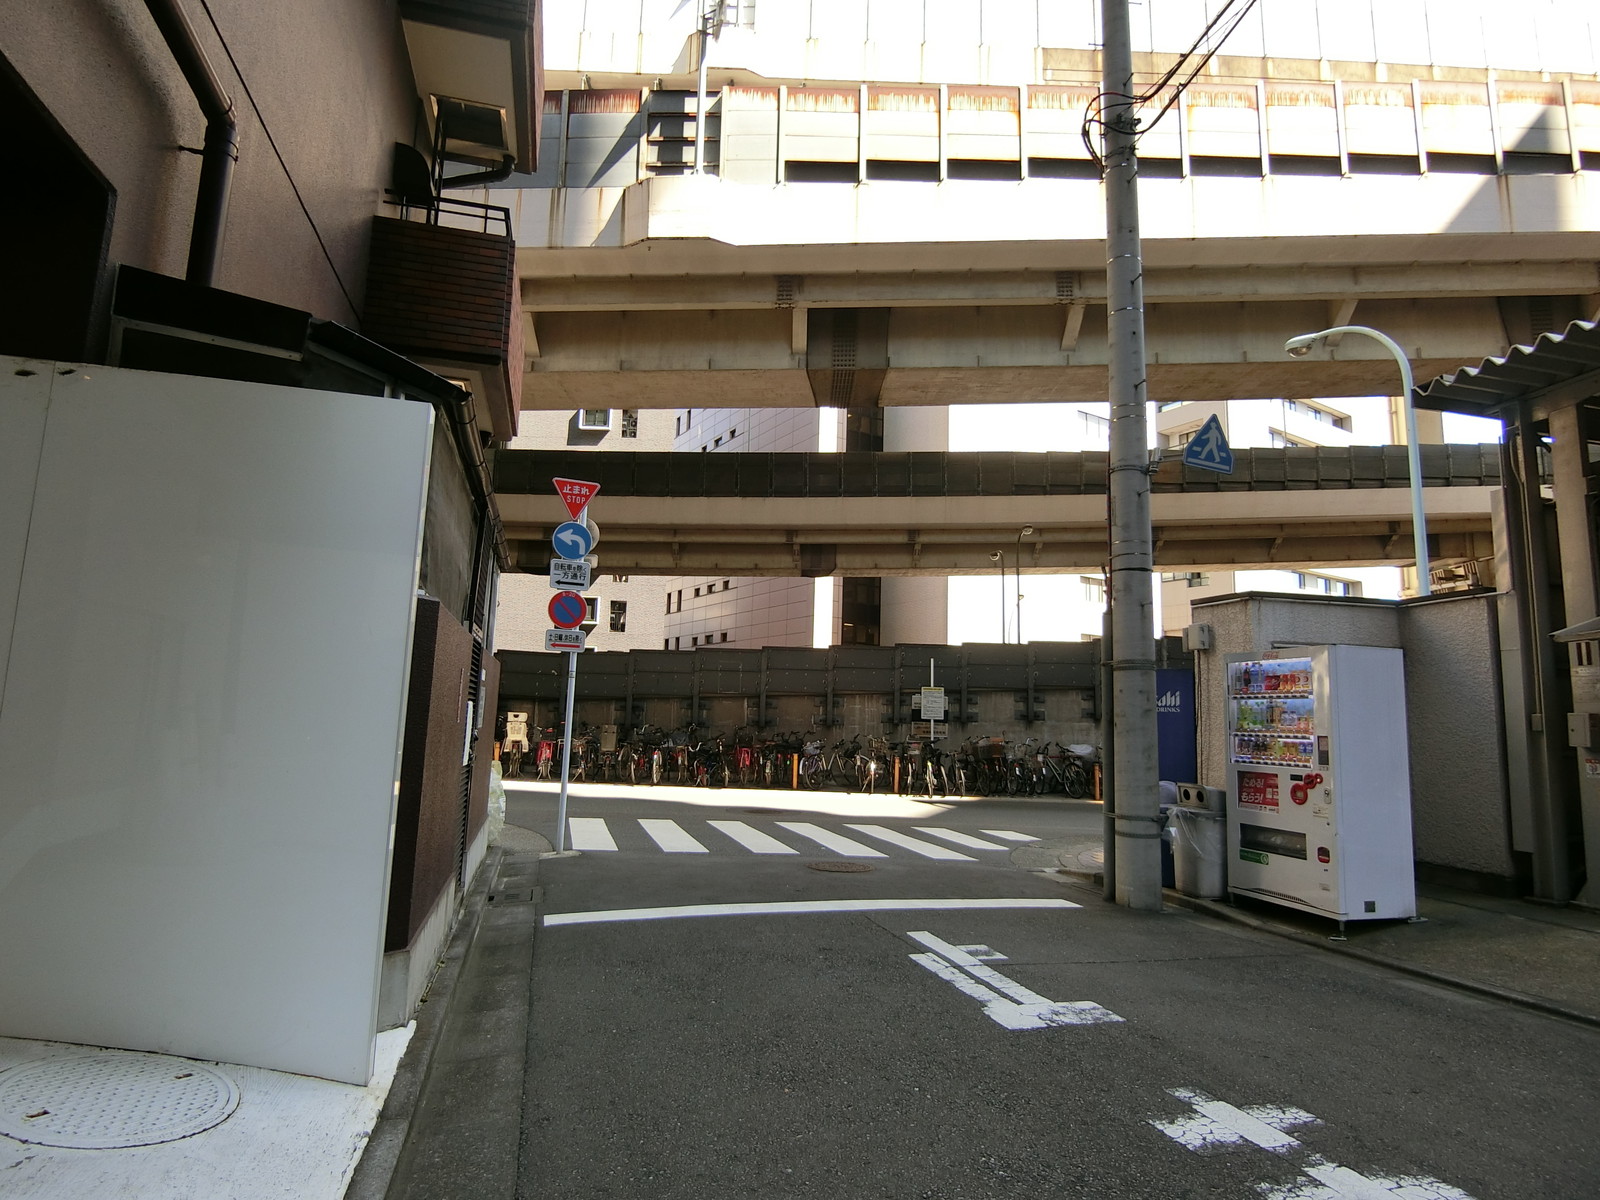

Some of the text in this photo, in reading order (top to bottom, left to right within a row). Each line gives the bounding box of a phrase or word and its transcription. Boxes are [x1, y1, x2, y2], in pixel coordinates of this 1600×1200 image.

[562, 484, 590, 495] 止まれ
[567, 495, 586, 504] STOP
[553, 572, 587, 581] 一方通行
[1241, 792, 1264, 803] もらう!
